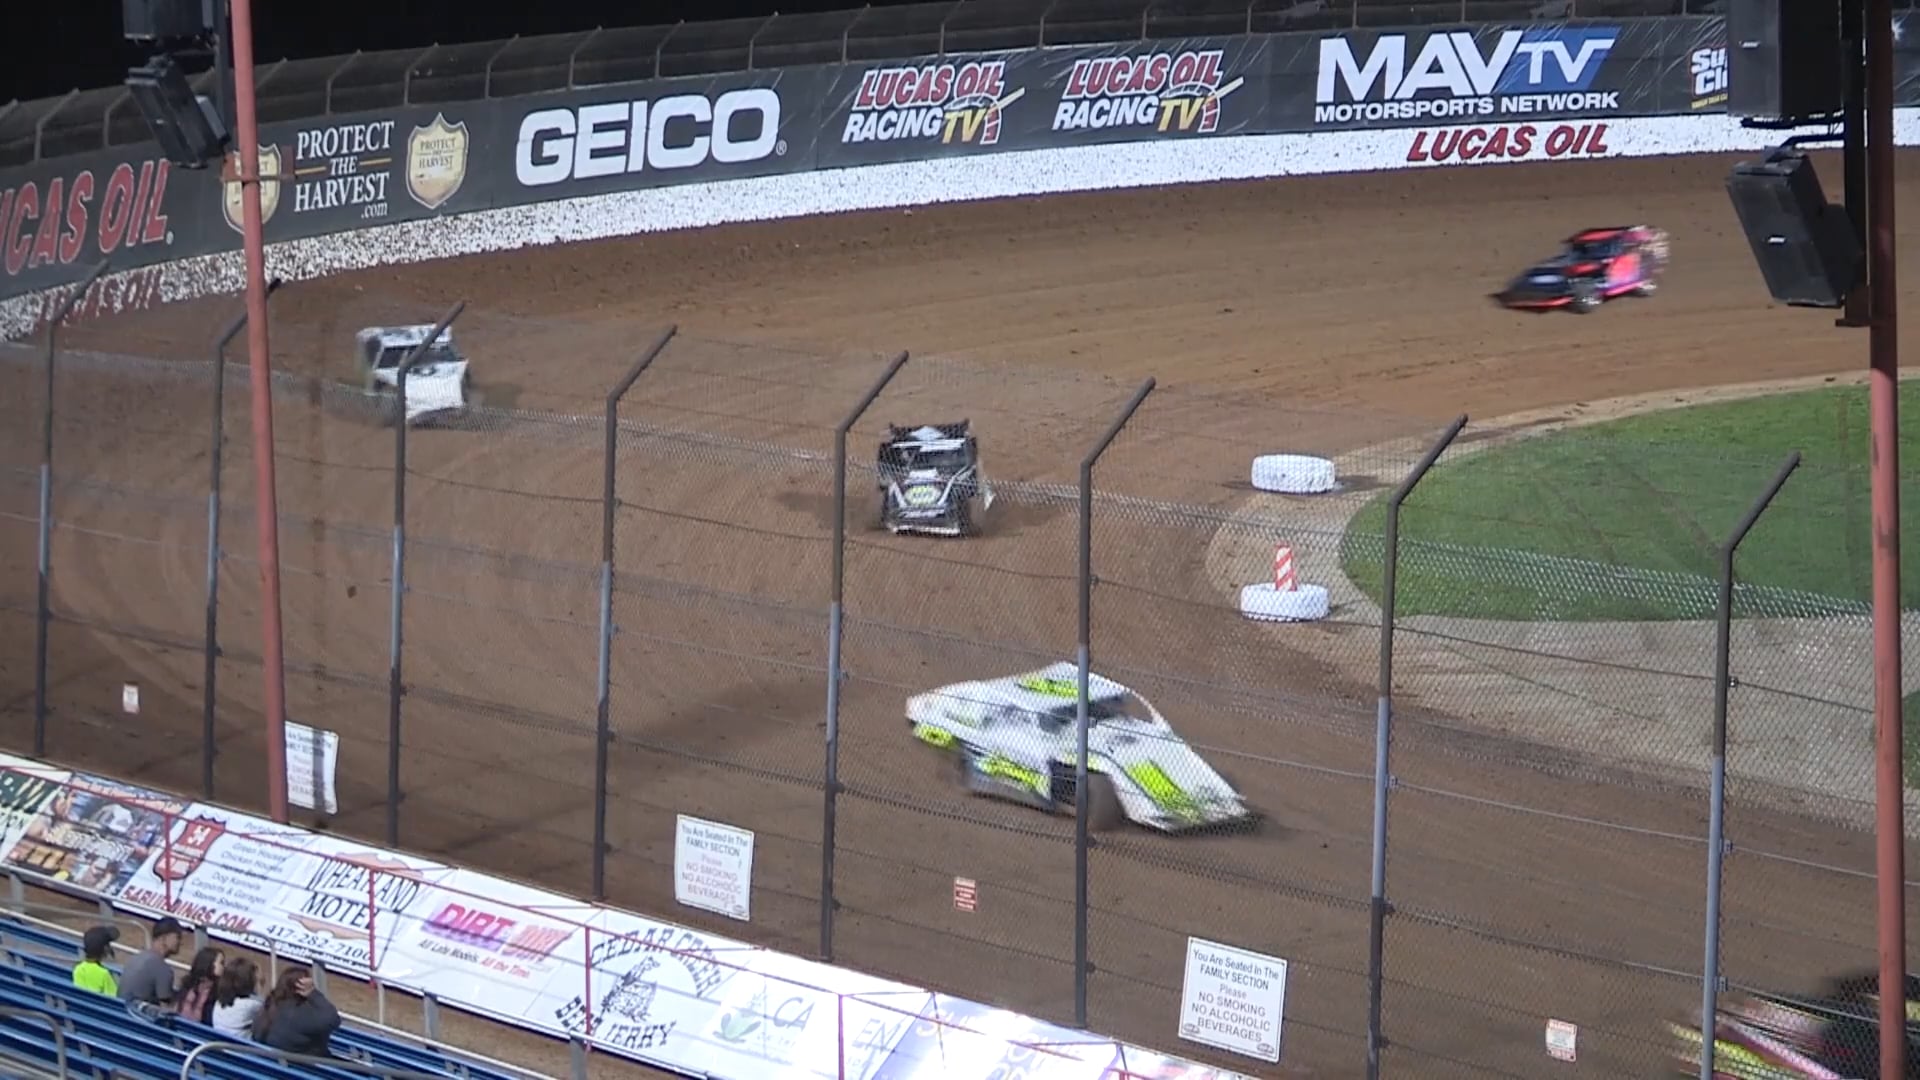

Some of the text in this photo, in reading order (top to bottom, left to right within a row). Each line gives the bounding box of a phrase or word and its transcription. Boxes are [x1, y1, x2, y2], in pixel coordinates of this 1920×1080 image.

[854, 60, 1006, 110] LUCAS OIL
[1062, 50, 1223, 99] LUCAS OIL
[1052, 96, 1159, 131] RACING
[1314, 91, 1620, 123] MOTORSPORTS NETWORK
[842, 106, 944, 144] RACING
[296, 120, 395, 160] PROTECT
[420, 137, 457, 151] PROTECT
[1406, 124, 1610, 162] LUCAS OIL
[329, 156, 359, 176] THE
[98, 158, 171, 254] OIL
[293, 172, 390, 213] HARVEST
[360, 202, 389, 219] .com
[682, 824, 692, 834] You
[694, 827, 704, 837] Are
[687, 837, 740, 857] FAMILY SECTION
[683, 872, 695, 882] NO
[687, 863, 699, 873] NO
[1194, 949, 1209, 962] You
[1210, 954, 1224, 966] Are
[1226, 958, 1254, 973] Seated
[1265, 968, 1280, 980] The
[1201, 964, 1270, 991] FAMILY SECTION
[1200, 992, 1266, 1018] NO SMOKING
[1220, 984, 1248, 999] Please
[1192, 1003, 1272, 1033] NO ALCOHOLIC
[1197, 1017, 1263, 1042] BEVERAGES
